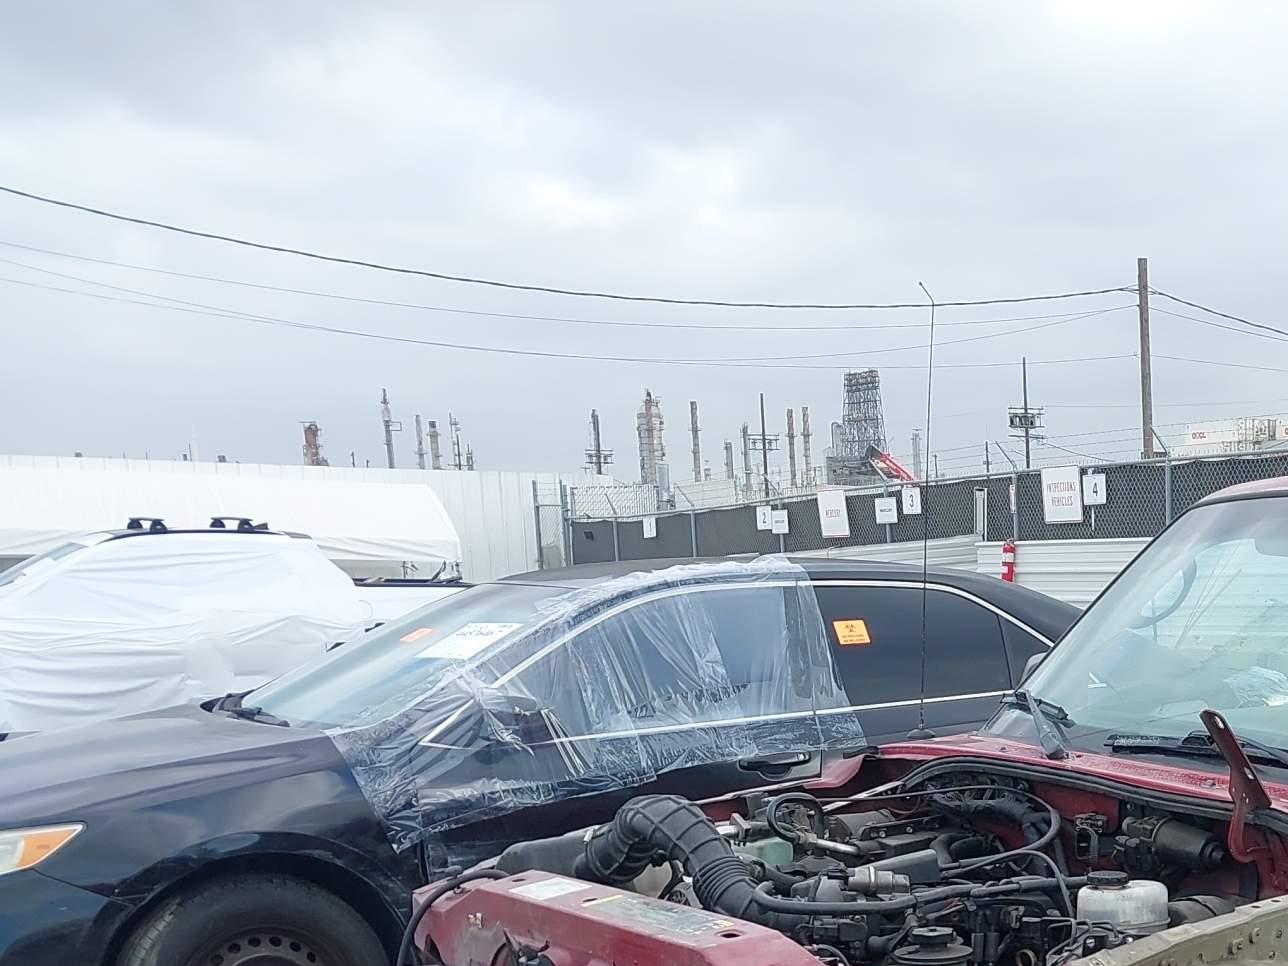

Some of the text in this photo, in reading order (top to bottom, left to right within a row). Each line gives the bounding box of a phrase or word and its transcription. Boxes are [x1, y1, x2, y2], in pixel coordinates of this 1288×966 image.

[1046, 481, 1076, 493] INSPECTIONS
[1092, 482, 1098, 497] 4
[909, 494, 914, 508] 3
[1051, 495, 1073, 507] VEHICLES
[762, 511, 767, 524] 2
